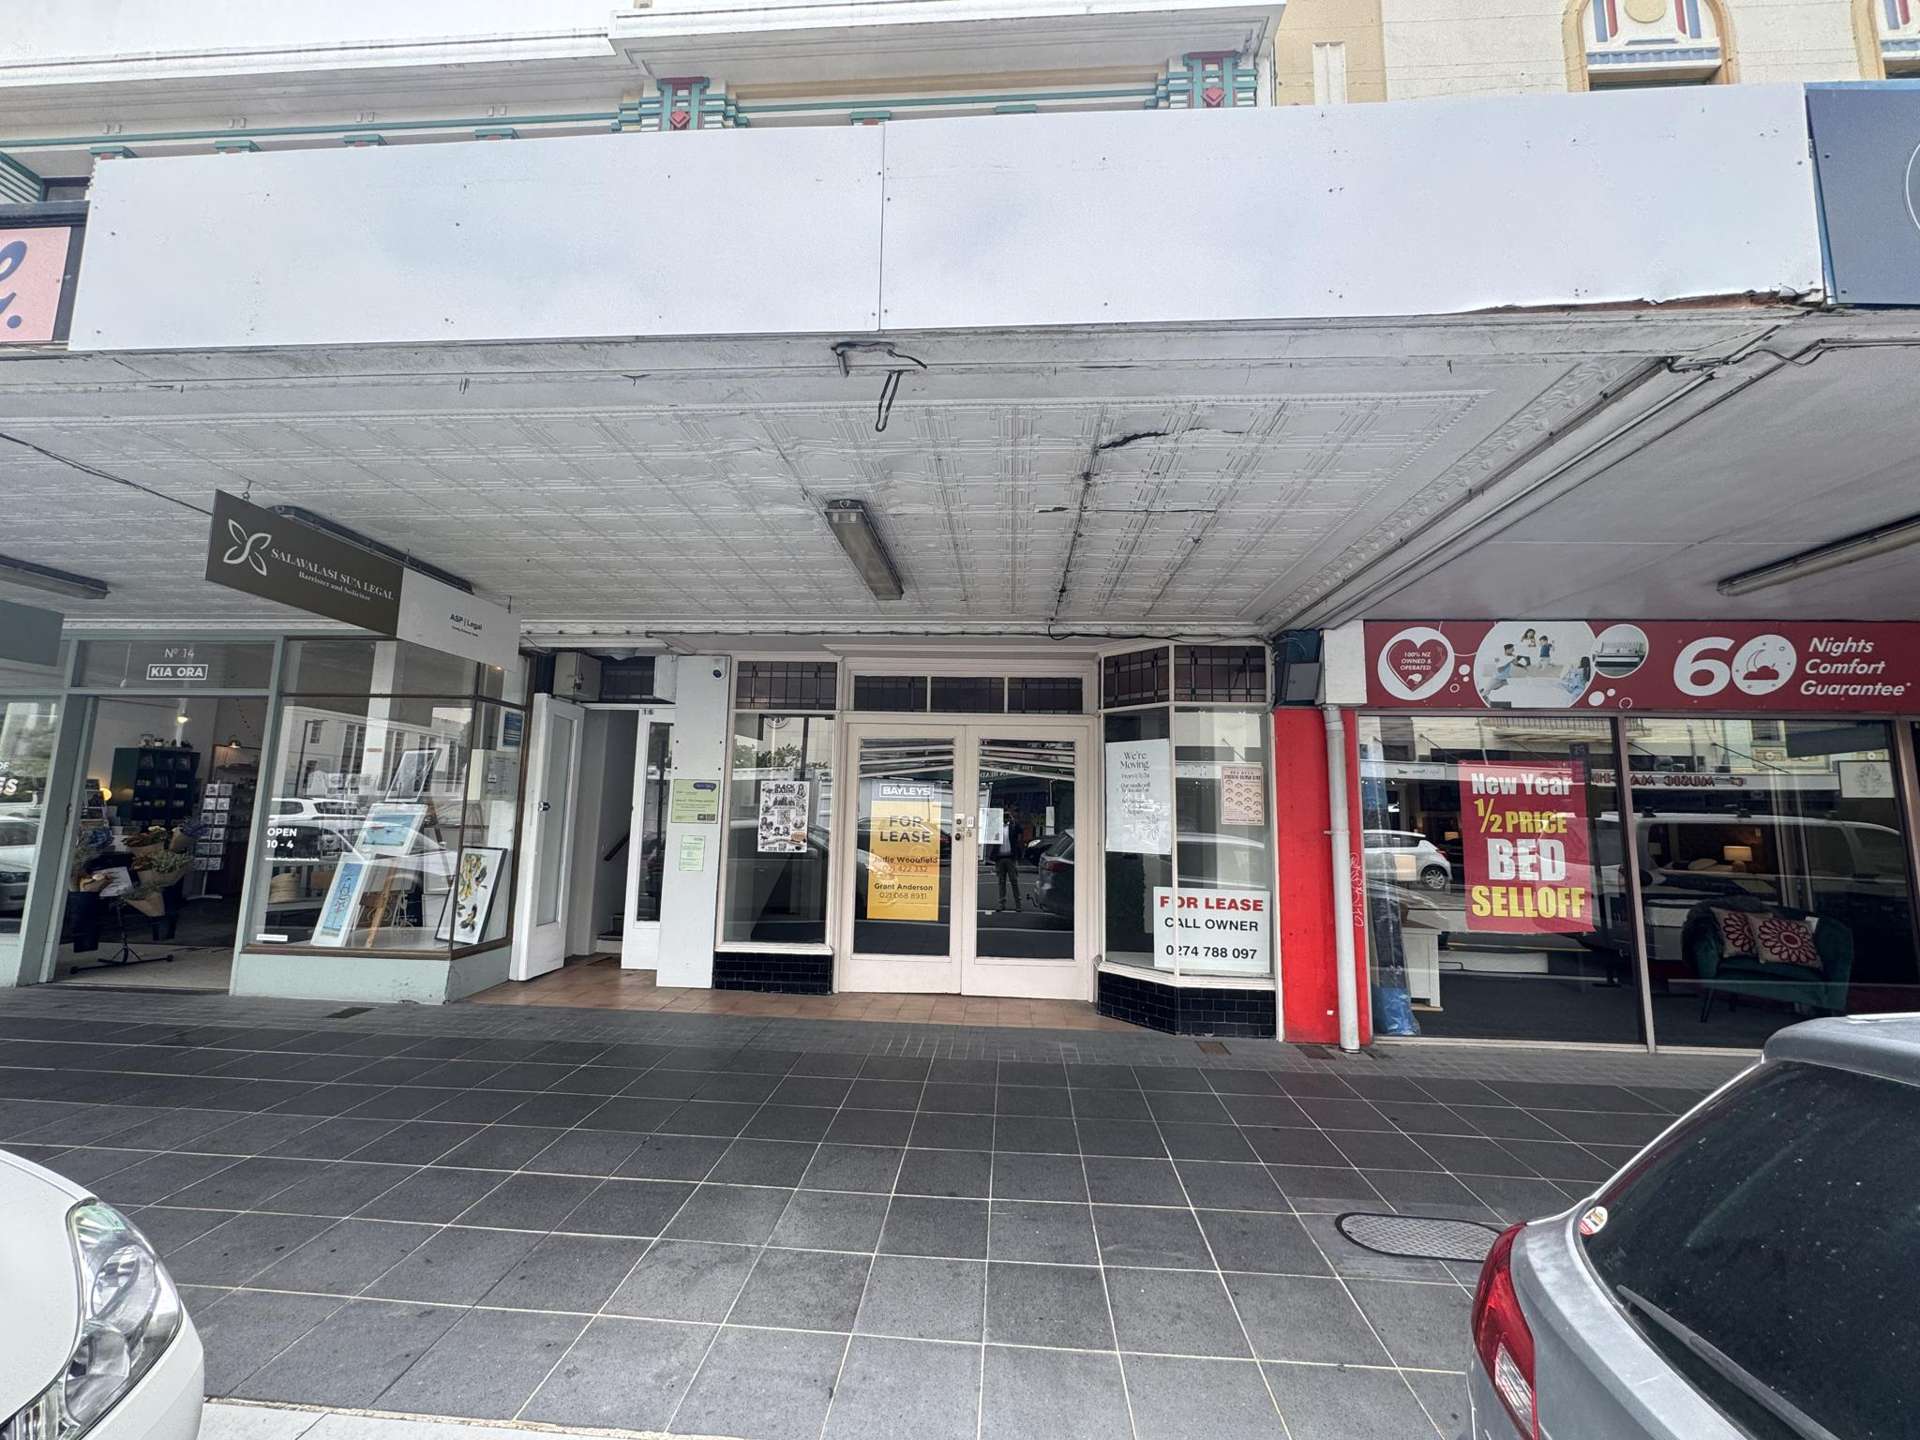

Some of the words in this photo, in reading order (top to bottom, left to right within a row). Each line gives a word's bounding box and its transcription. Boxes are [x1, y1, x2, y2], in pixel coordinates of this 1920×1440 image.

[363, 582, 394, 600] LEGAL
[1808, 637, 1875, 657] Nights
[151, 667, 173, 677] KIA
[176, 667, 204, 677] ORA
[1804, 659, 1886, 675] Comfort
[1123, 751, 1147, 760] We're
[1120, 761, 1151, 771] Moving
[1471, 773, 1517, 795] New
[1521, 773, 1572, 796] Year
[883, 787, 931, 796] BAYLEYS
[889, 816, 922, 827] FOR
[1505, 811, 1568, 833] PRICE
[267, 828, 298, 837] OPEN
[879, 831, 931, 843] LEASE
[266, 840, 278, 849] 10
[286, 840, 294, 848] 4
[1487, 838, 1566, 881] BED
[897, 884, 933, 892] Anderson
[1204, 898, 1264, 911] LEASE
[1471, 885, 1585, 918] SELLOFF
[1205, 919, 1259, 931] OWNER
[1203, 947, 1228, 958] 788
[1232, 948, 1257, 959] 097
